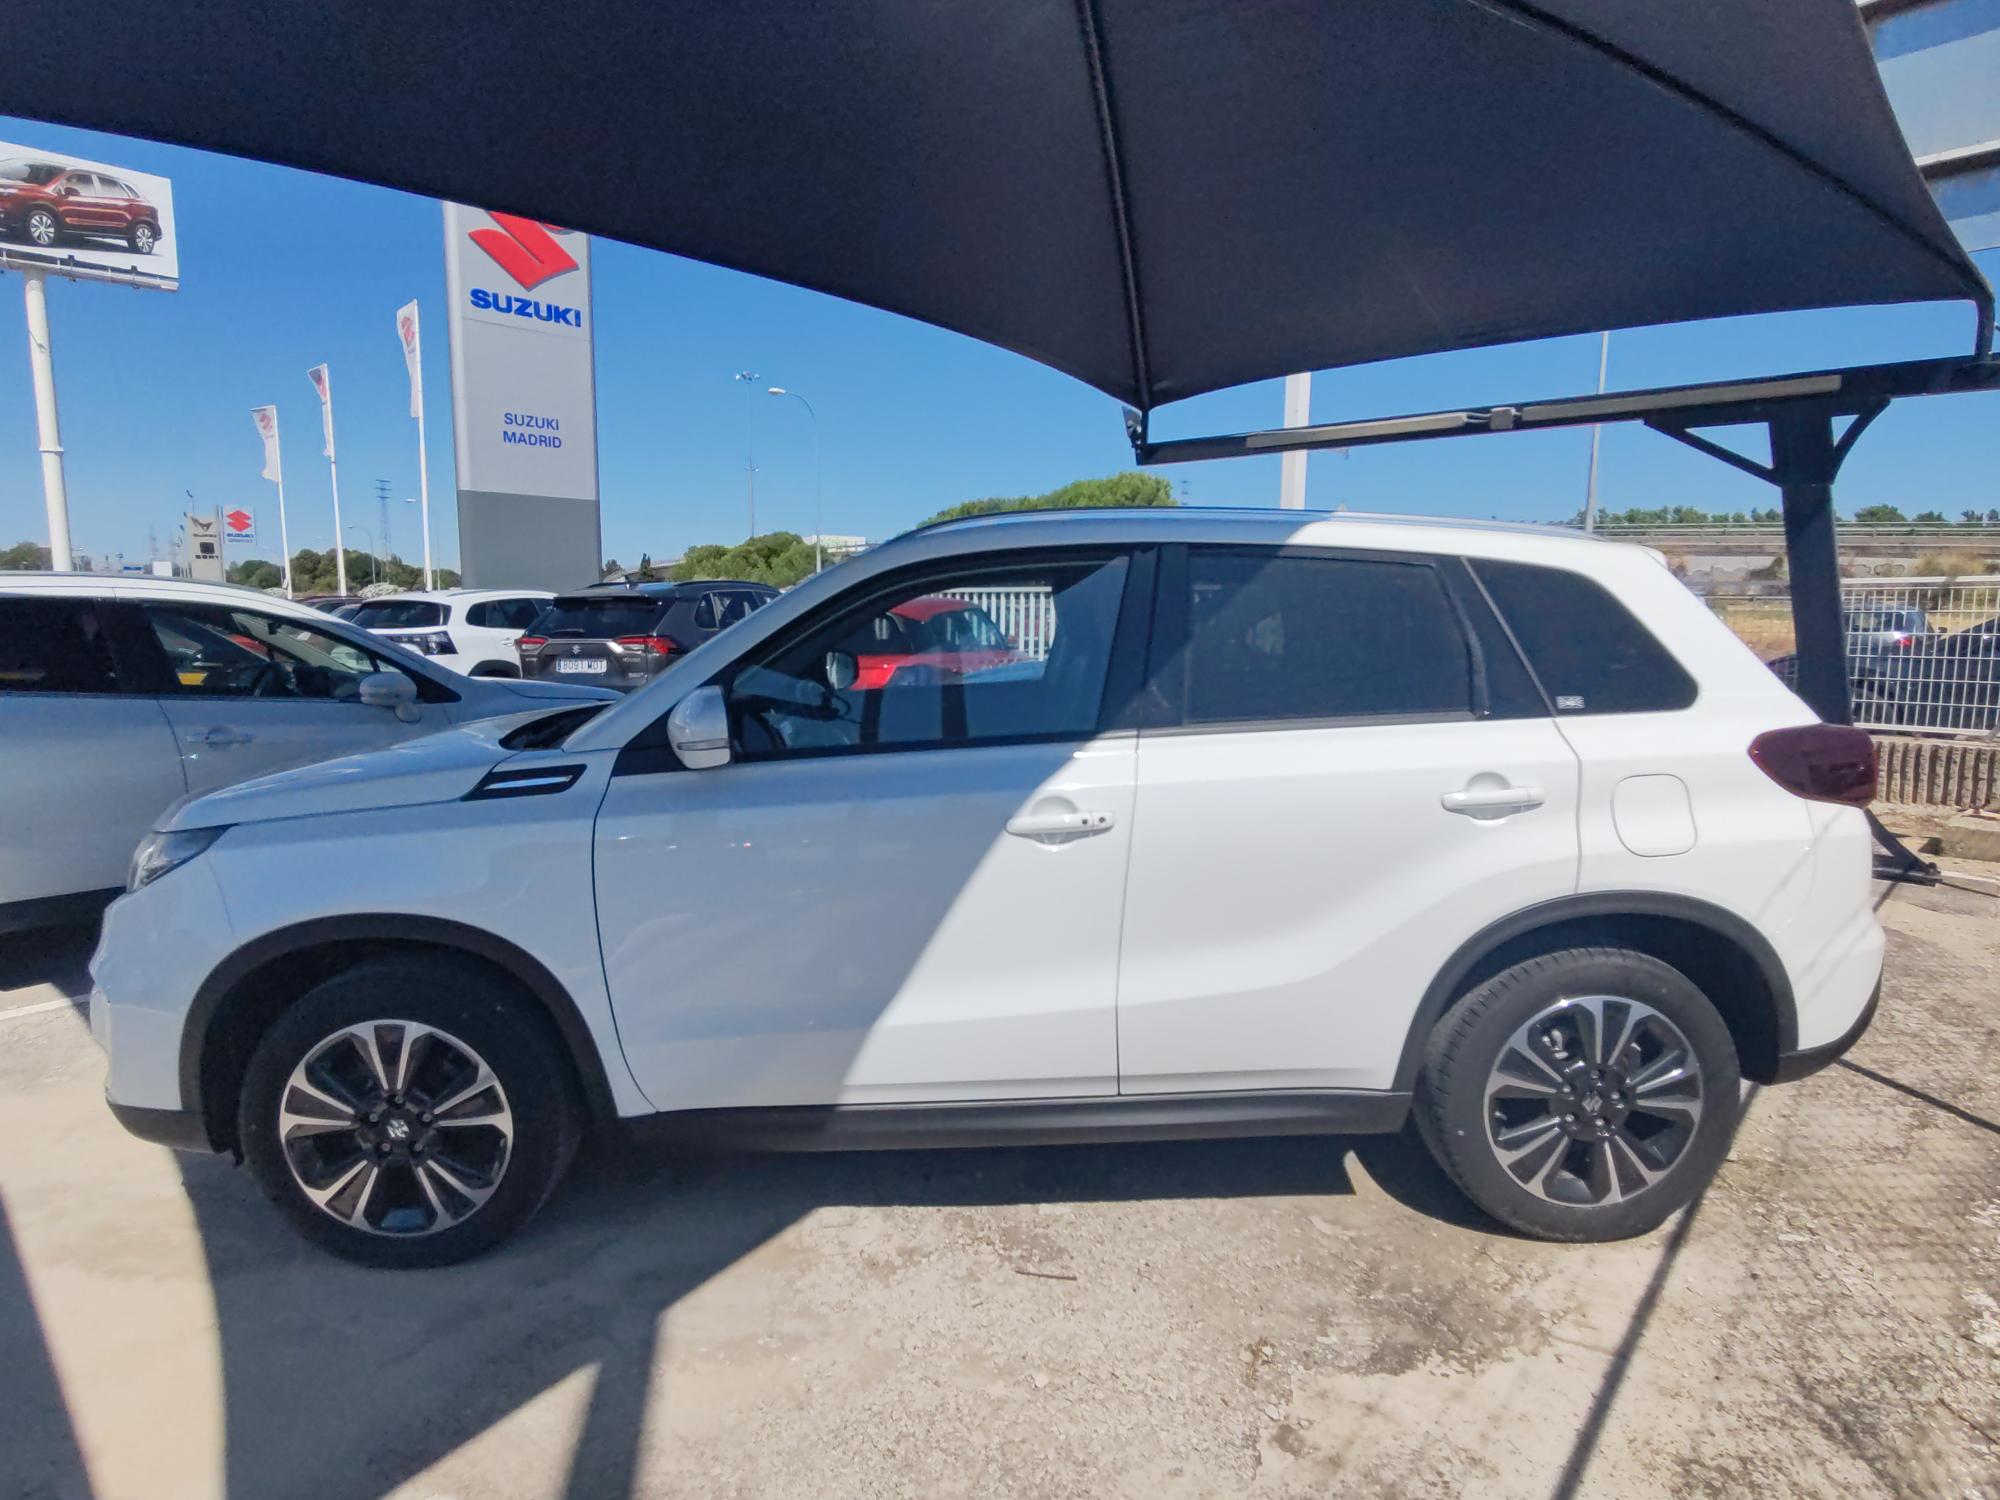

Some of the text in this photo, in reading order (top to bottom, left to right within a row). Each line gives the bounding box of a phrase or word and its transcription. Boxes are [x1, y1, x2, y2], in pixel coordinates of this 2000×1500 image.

[470, 288, 581, 327] SUZUKI
[504, 412, 559, 430] SUZUKI
[503, 431, 562, 448] MADRID
